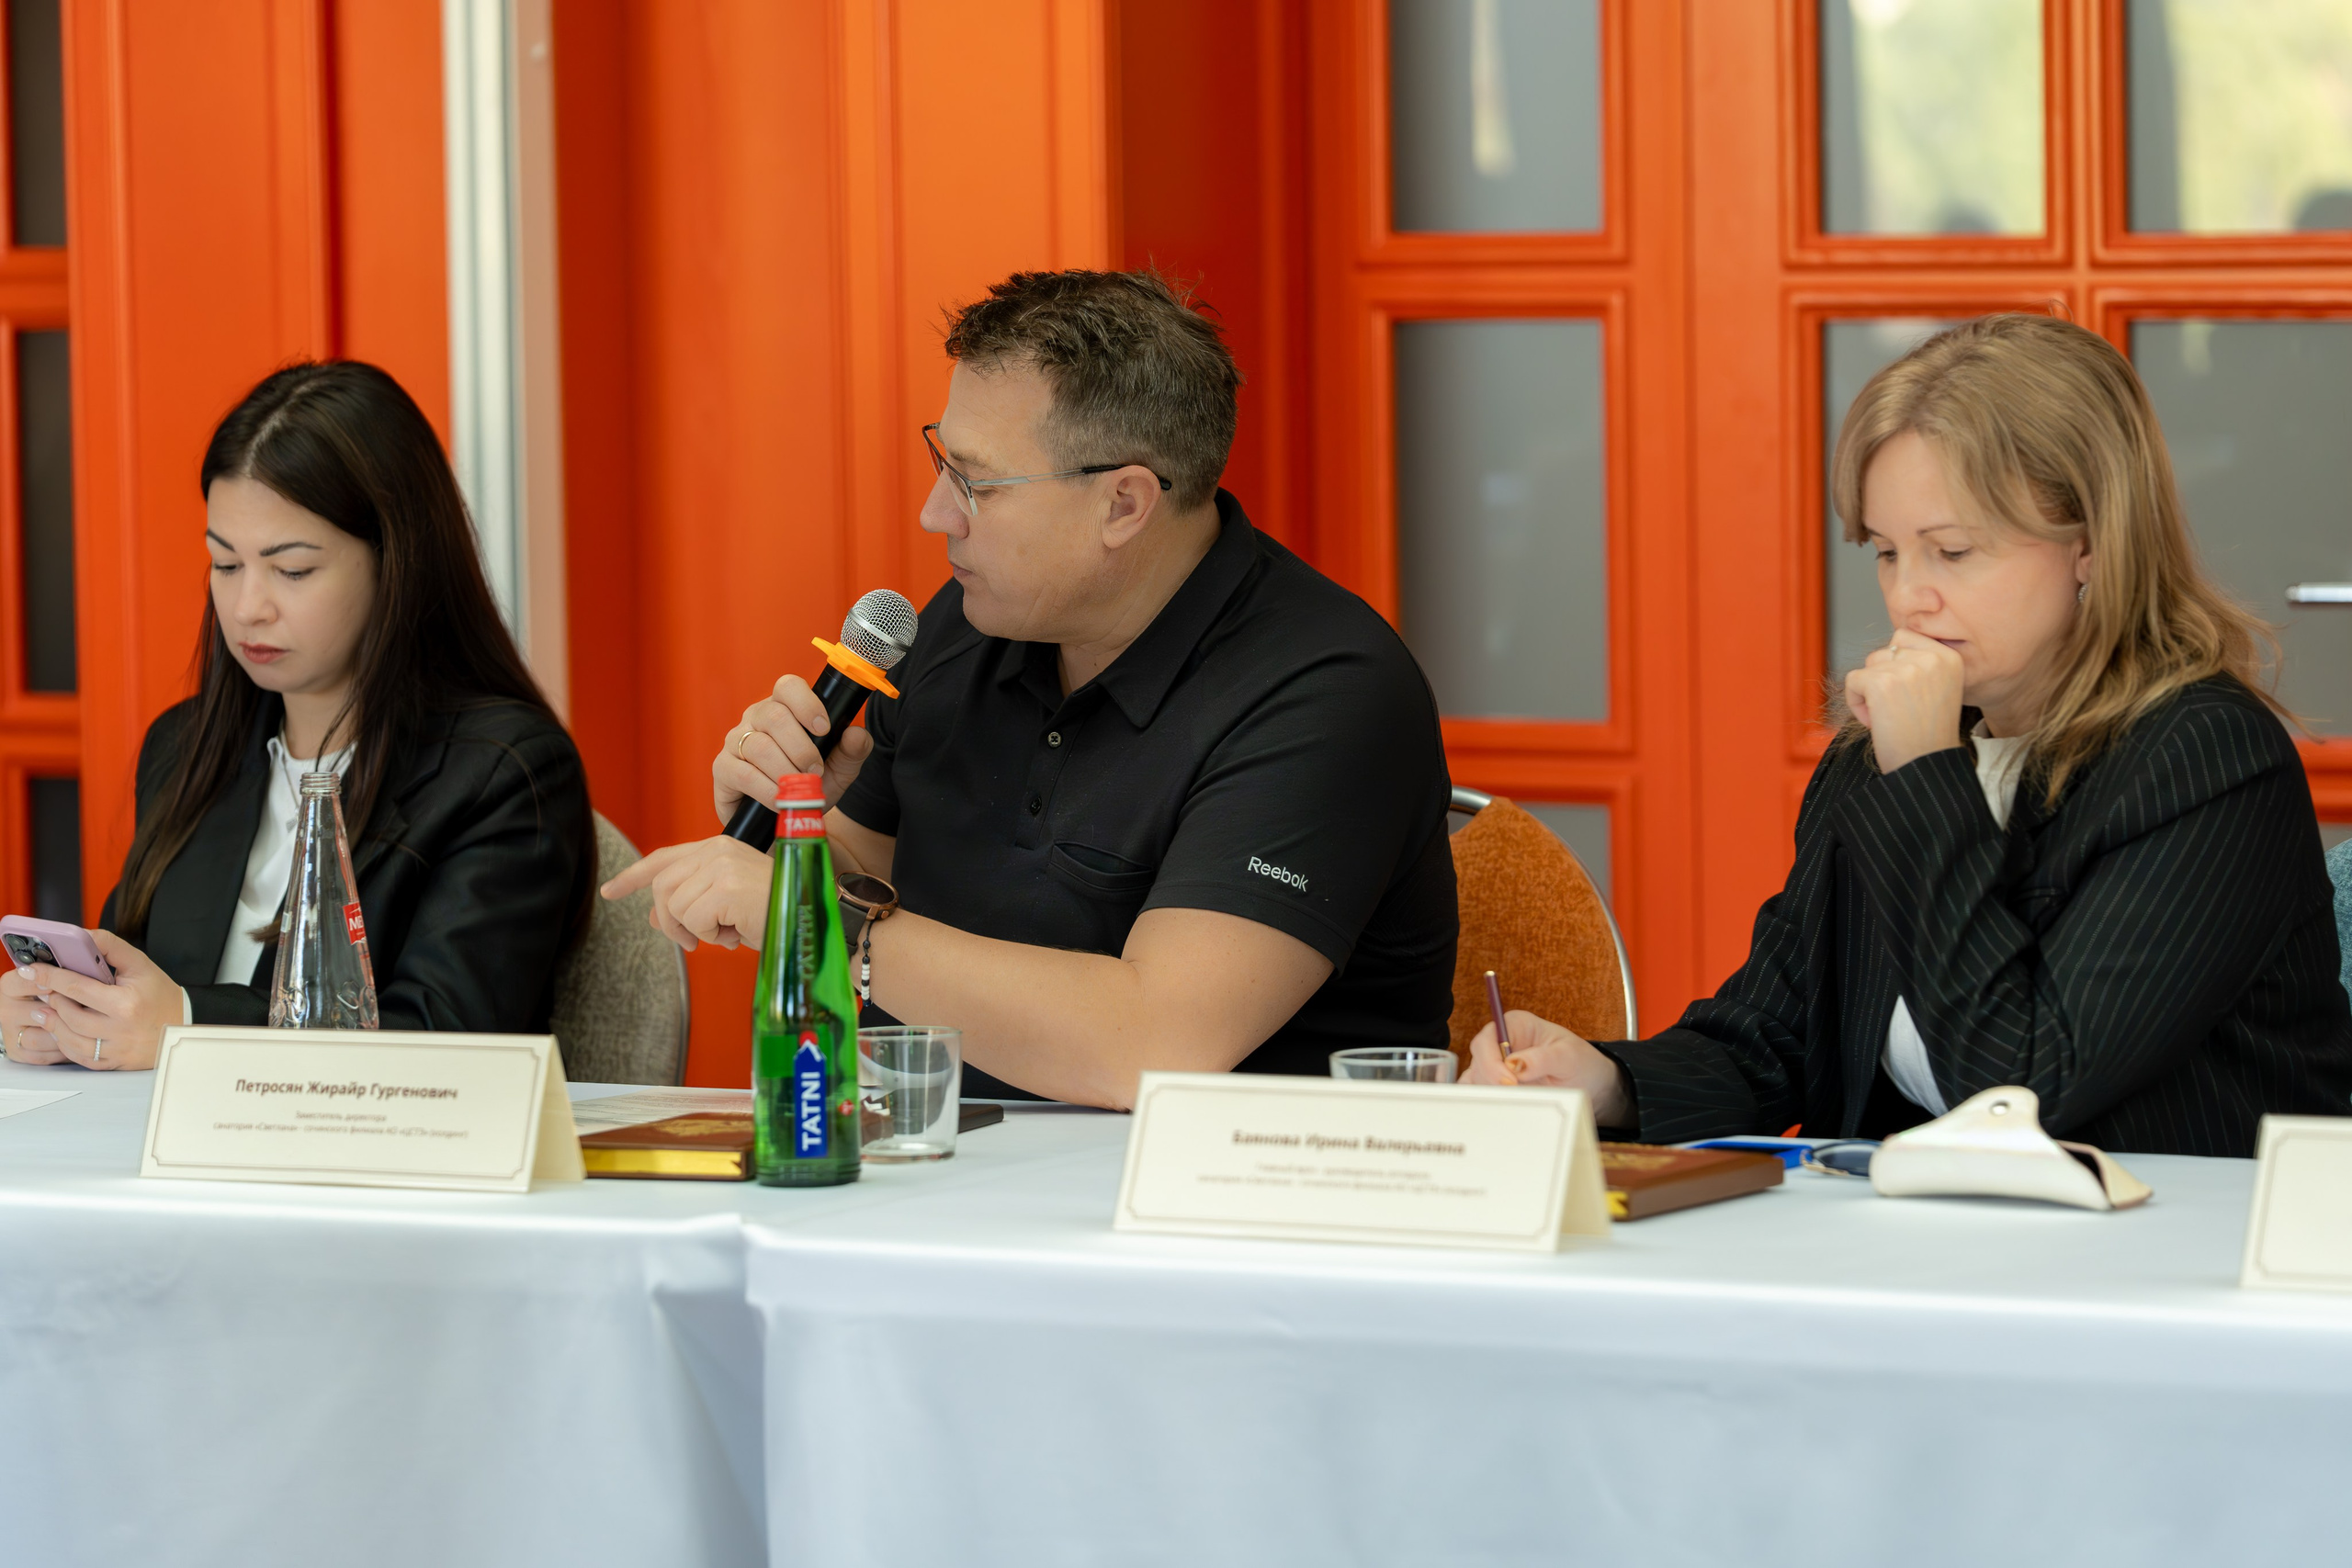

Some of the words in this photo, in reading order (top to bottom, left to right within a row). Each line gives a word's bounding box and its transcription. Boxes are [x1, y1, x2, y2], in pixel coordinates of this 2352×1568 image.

[1248, 856, 1309, 892] Reebok
[235, 1078, 303, 1096] Петросян
[306, 1080, 367, 1099] Жирайр
[369, 1083, 458, 1100] Гургенович
[801, 1071, 822, 1152] TATNI
[1305, 1133, 1360, 1152] Ирина
[1364, 1135, 1466, 1156] Валерьевна
